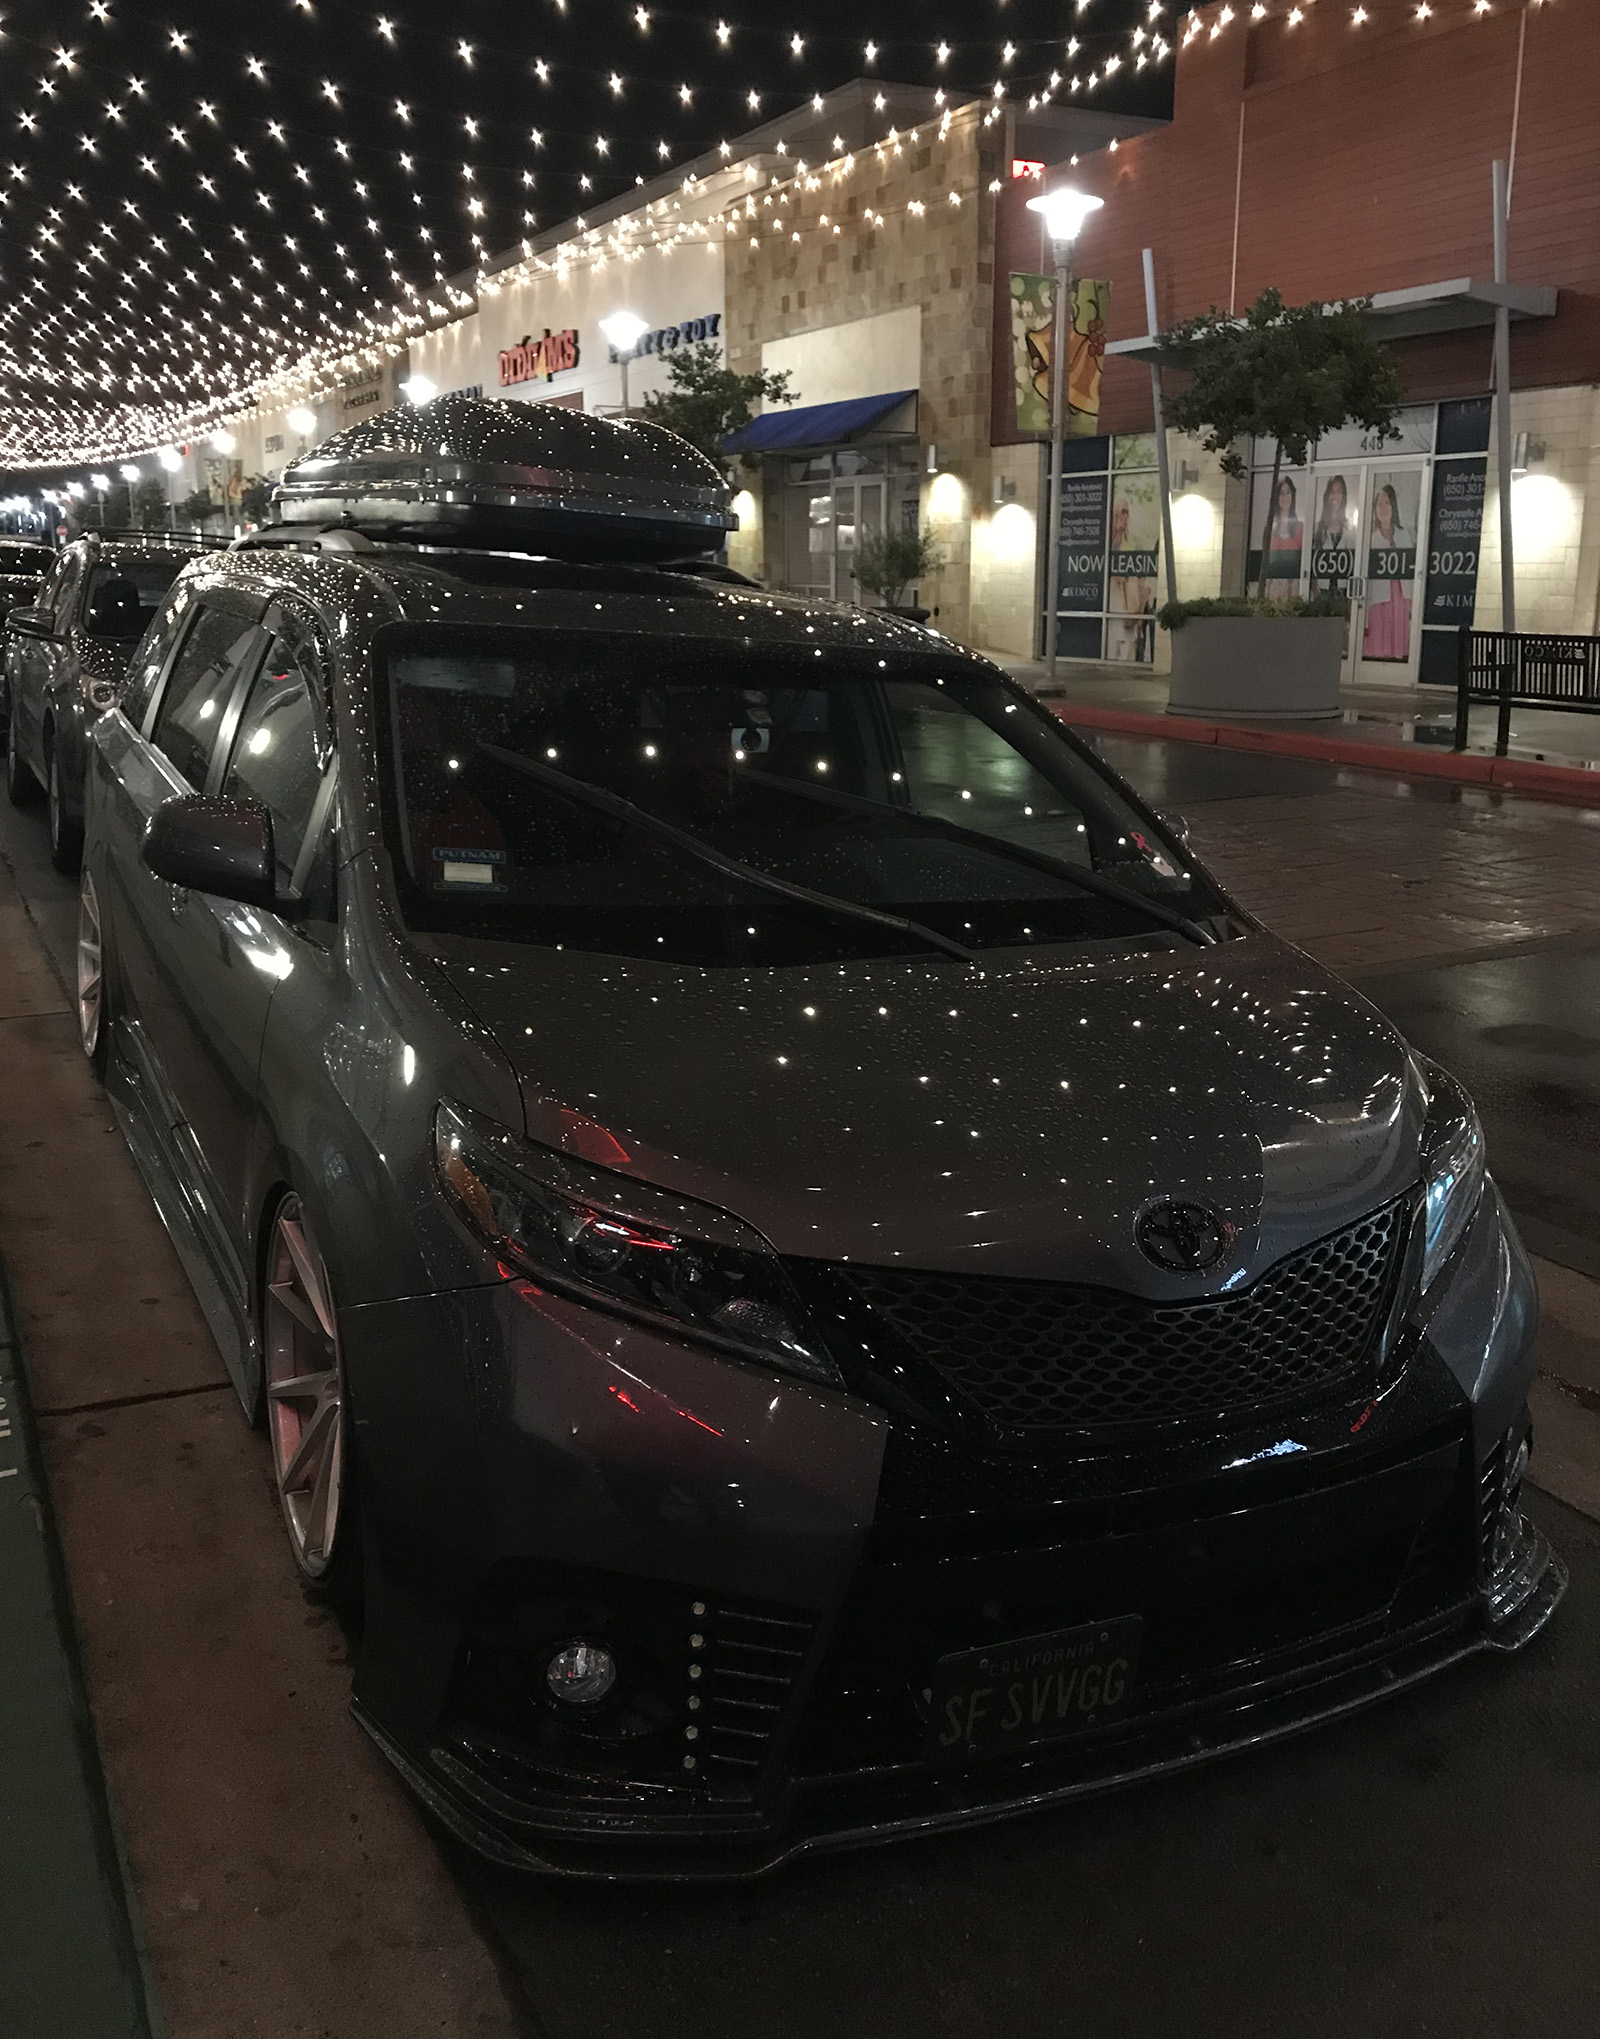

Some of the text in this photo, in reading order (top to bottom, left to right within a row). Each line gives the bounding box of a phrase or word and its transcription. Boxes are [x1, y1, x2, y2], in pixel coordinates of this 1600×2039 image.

[680, 313, 721, 343] TOY
[1067, 554, 1158, 573] NOW LEASIN
[1312, 549, 1355, 578] (650)
[1429, 551, 1476, 575] 3022
[1446, 595, 1473, 607] KIM
[439, 850, 501, 860] PUTNAM
[989, 1641, 1095, 1676] CALIFORNIA
[938, 1658, 1128, 1747] SF SVVGG
